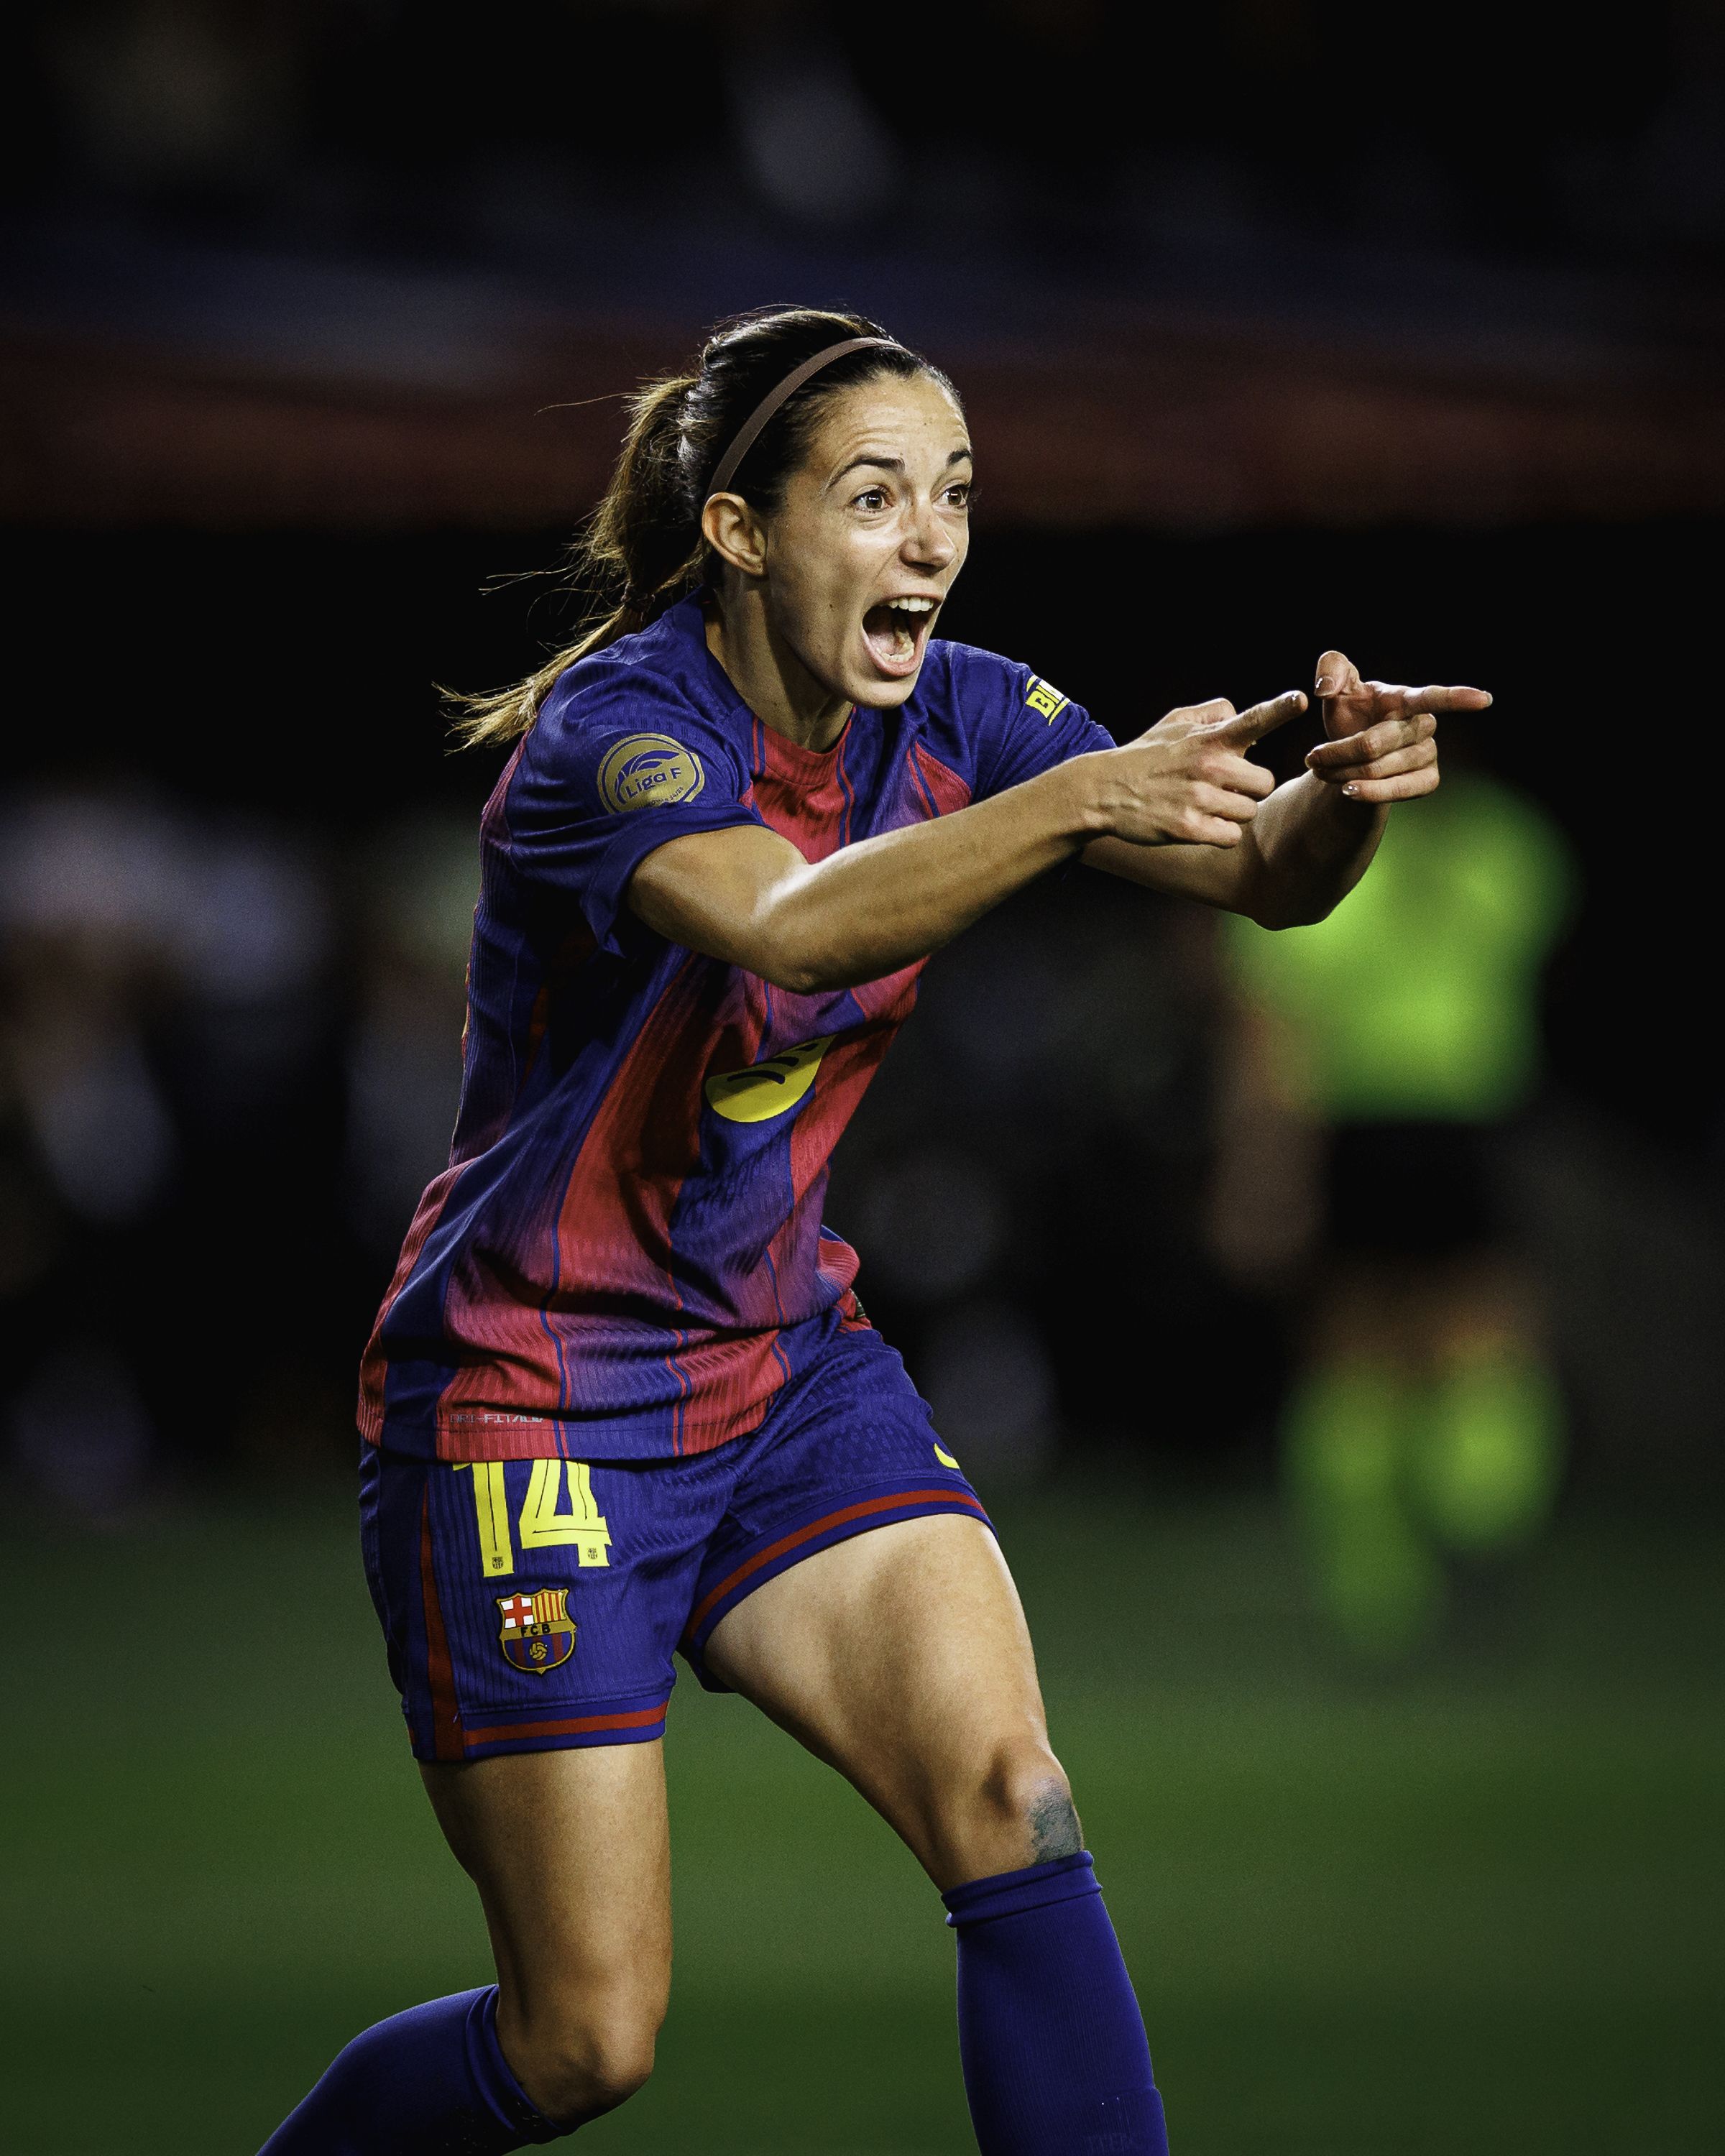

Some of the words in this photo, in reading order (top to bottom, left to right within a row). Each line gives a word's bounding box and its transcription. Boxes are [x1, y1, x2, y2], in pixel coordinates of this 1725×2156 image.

[625, 772, 667, 798] Liga
[670, 767, 681, 780] F
[452, 1459, 612, 1577] 14
